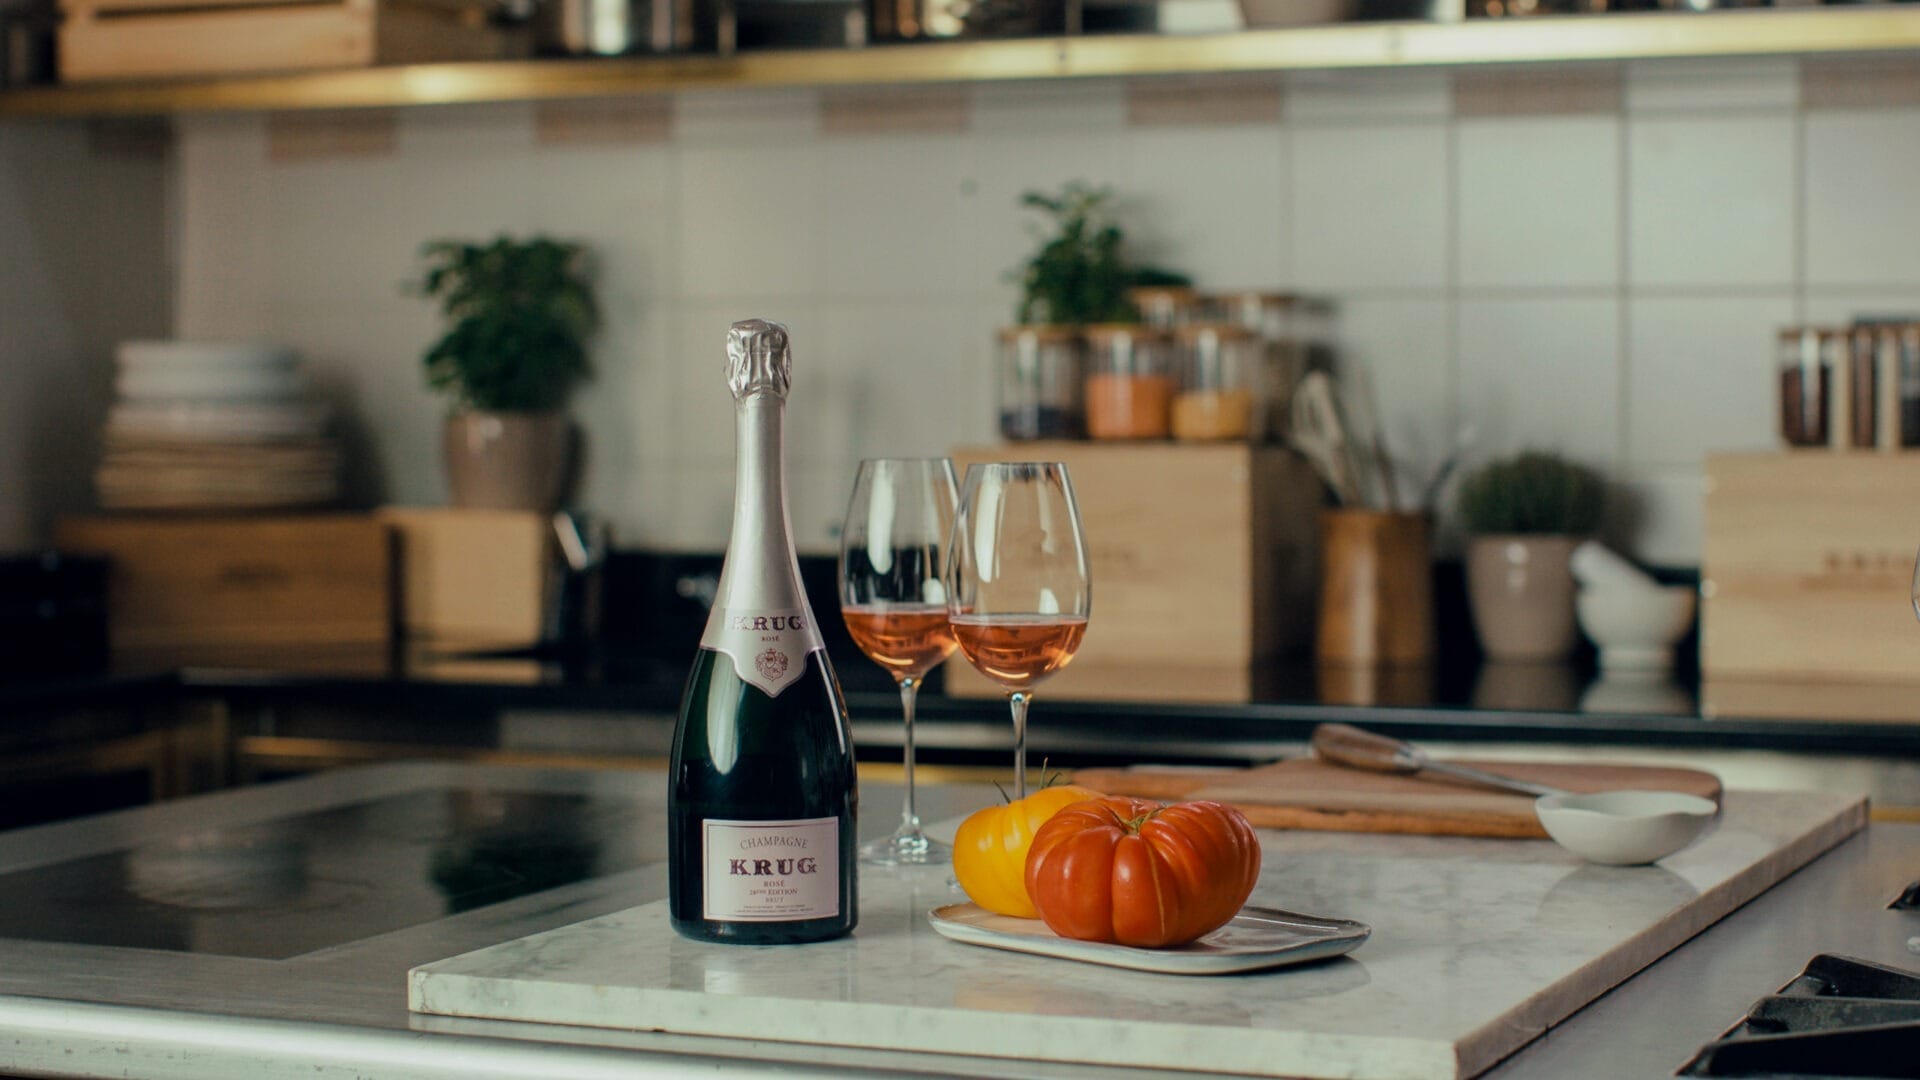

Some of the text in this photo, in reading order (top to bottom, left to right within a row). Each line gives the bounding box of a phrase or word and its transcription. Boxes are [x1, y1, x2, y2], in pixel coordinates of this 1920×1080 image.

[731, 615, 804, 631] KRUG
[740, 836, 809, 850] CHAMPAGNE
[729, 857, 818, 876] KRUG
